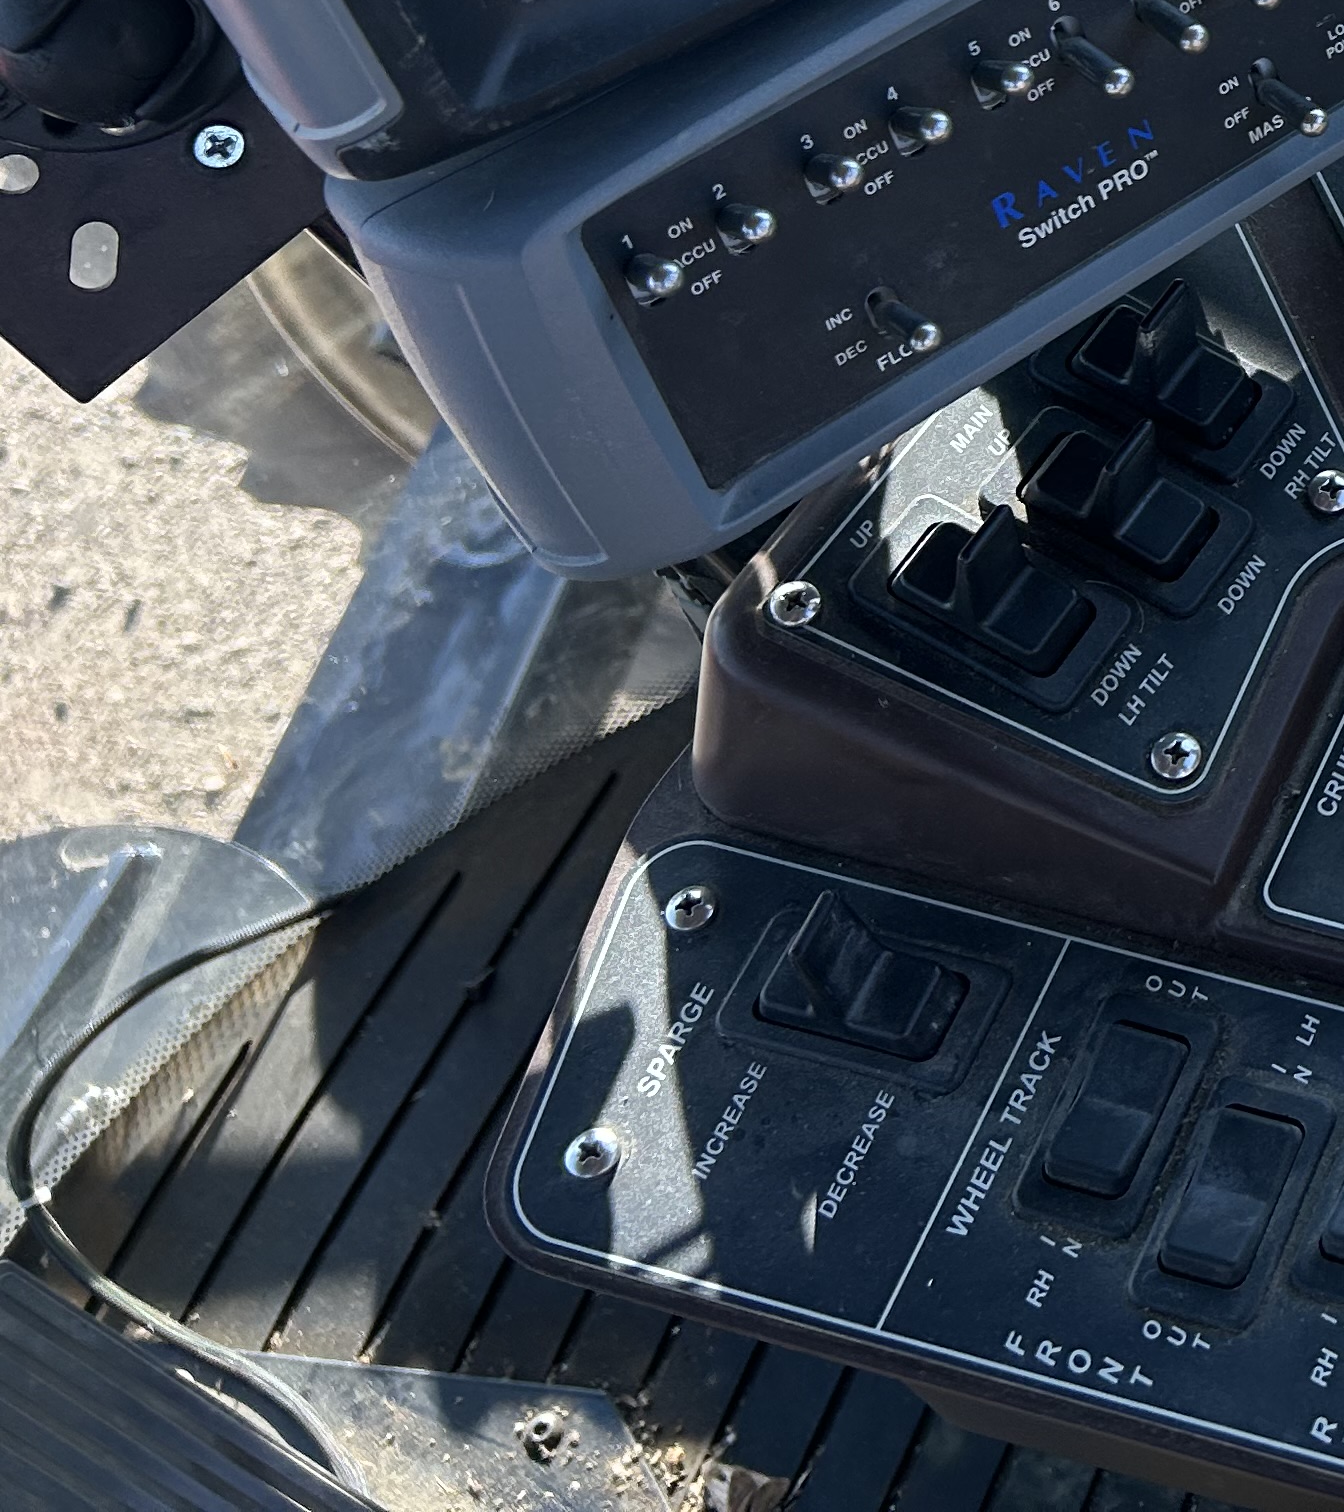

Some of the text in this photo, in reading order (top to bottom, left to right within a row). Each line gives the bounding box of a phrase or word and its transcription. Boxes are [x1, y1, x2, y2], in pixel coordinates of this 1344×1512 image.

[968, 40, 981, 56] 5
[1008, 27, 1032, 47] ON
[1022, 48, 1050, 67] CU
[887, 86, 899, 100] 4
[1027, 78, 1056, 102] OFF
[1218, 76, 1240, 95] ON
[843, 119, 868, 140] ON
[1224, 107, 1250, 130] OFF
[1248, 114, 1285, 144] MAS
[801, 134, 815, 150] 3
[855, 140, 889, 166] CCU
[863, 170, 895, 197] OFF
[990, 119, 1154, 228] RAVEN
[712, 183, 727, 200] 2
[667, 216, 694, 240] ON
[1018, 194, 1096, 248] Switch
[621, 234, 634, 250] 1
[690, 269, 723, 297] OFF
[825, 308, 854, 331] INC
[834, 339, 868, 366] DEC
[950, 404, 993, 453] MAIN
[988, 428, 1010, 456] UP
[1259, 423, 1308, 481] DOWN
[1284, 431, 1338, 500] RH TILT
[850, 520, 874, 548] UP
[1217, 554, 1268, 616] DOWN
[1090, 643, 1143, 707] DOWN
[1118, 653, 1175, 726] LH TILT
[1145, 975, 1210, 1001] OUT
[637, 983, 715, 1097] SPARGE
[1296, 1014, 1321, 1047] LH
[1271, 1063, 1313, 1085] IN
[692, 1061, 768, 1180] INCREASE
[947, 1031, 1062, 1237] WHEEL TRACK
[818, 1090, 895, 1219] DECREASE
[1040, 1235, 1082, 1258] IN
[1026, 1270, 1054, 1307] RH
[1142, 1319, 1212, 1350] OUT
[1004, 1331, 1155, 1389] FRONT
[1310, 1349, 1339, 1387] RH
